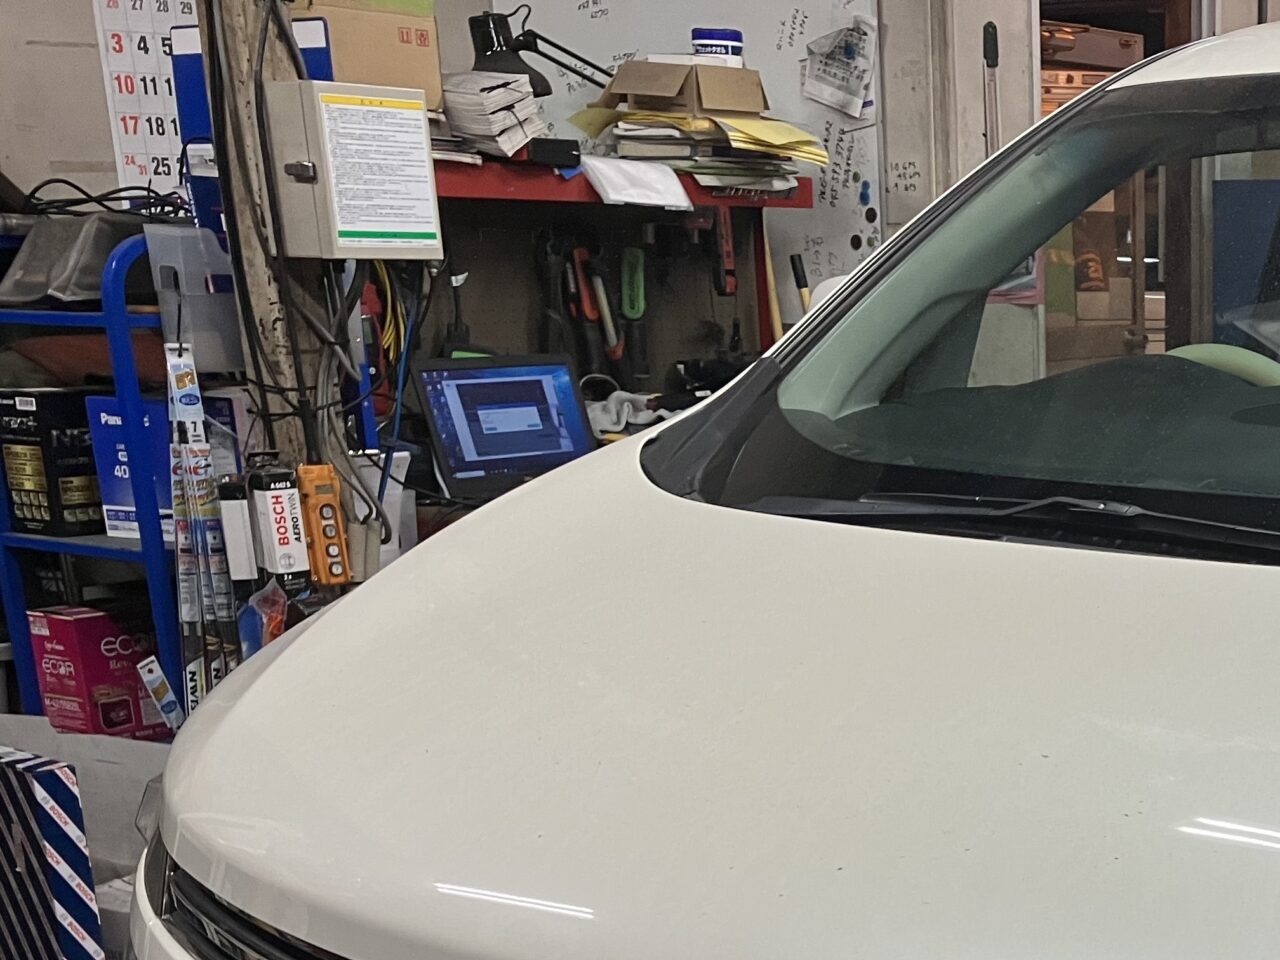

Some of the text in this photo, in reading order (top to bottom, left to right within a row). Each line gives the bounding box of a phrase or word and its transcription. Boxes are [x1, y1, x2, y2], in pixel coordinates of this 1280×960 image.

[131, 0, 144, 11] 27
[156, 0, 169, 13] 28
[180, 2, 193, 15] 29
[111, 33, 172, 56] 3 4 5
[114, 74, 135, 95] 10
[140, 75, 158, 96] 11
[120, 115, 139, 135] 17
[145, 116, 166, 136] 18
[124, 154, 172, 176] 24 25
[114, 464, 129, 478] 40
[271, 494, 290, 546] BOSCH
[287, 492, 303, 544] AEROTWIN
[49, 805, 69, 826] BOSCH
[75, 882, 94, 902] BOSCH
[67, 921, 86, 941] BOSCH
